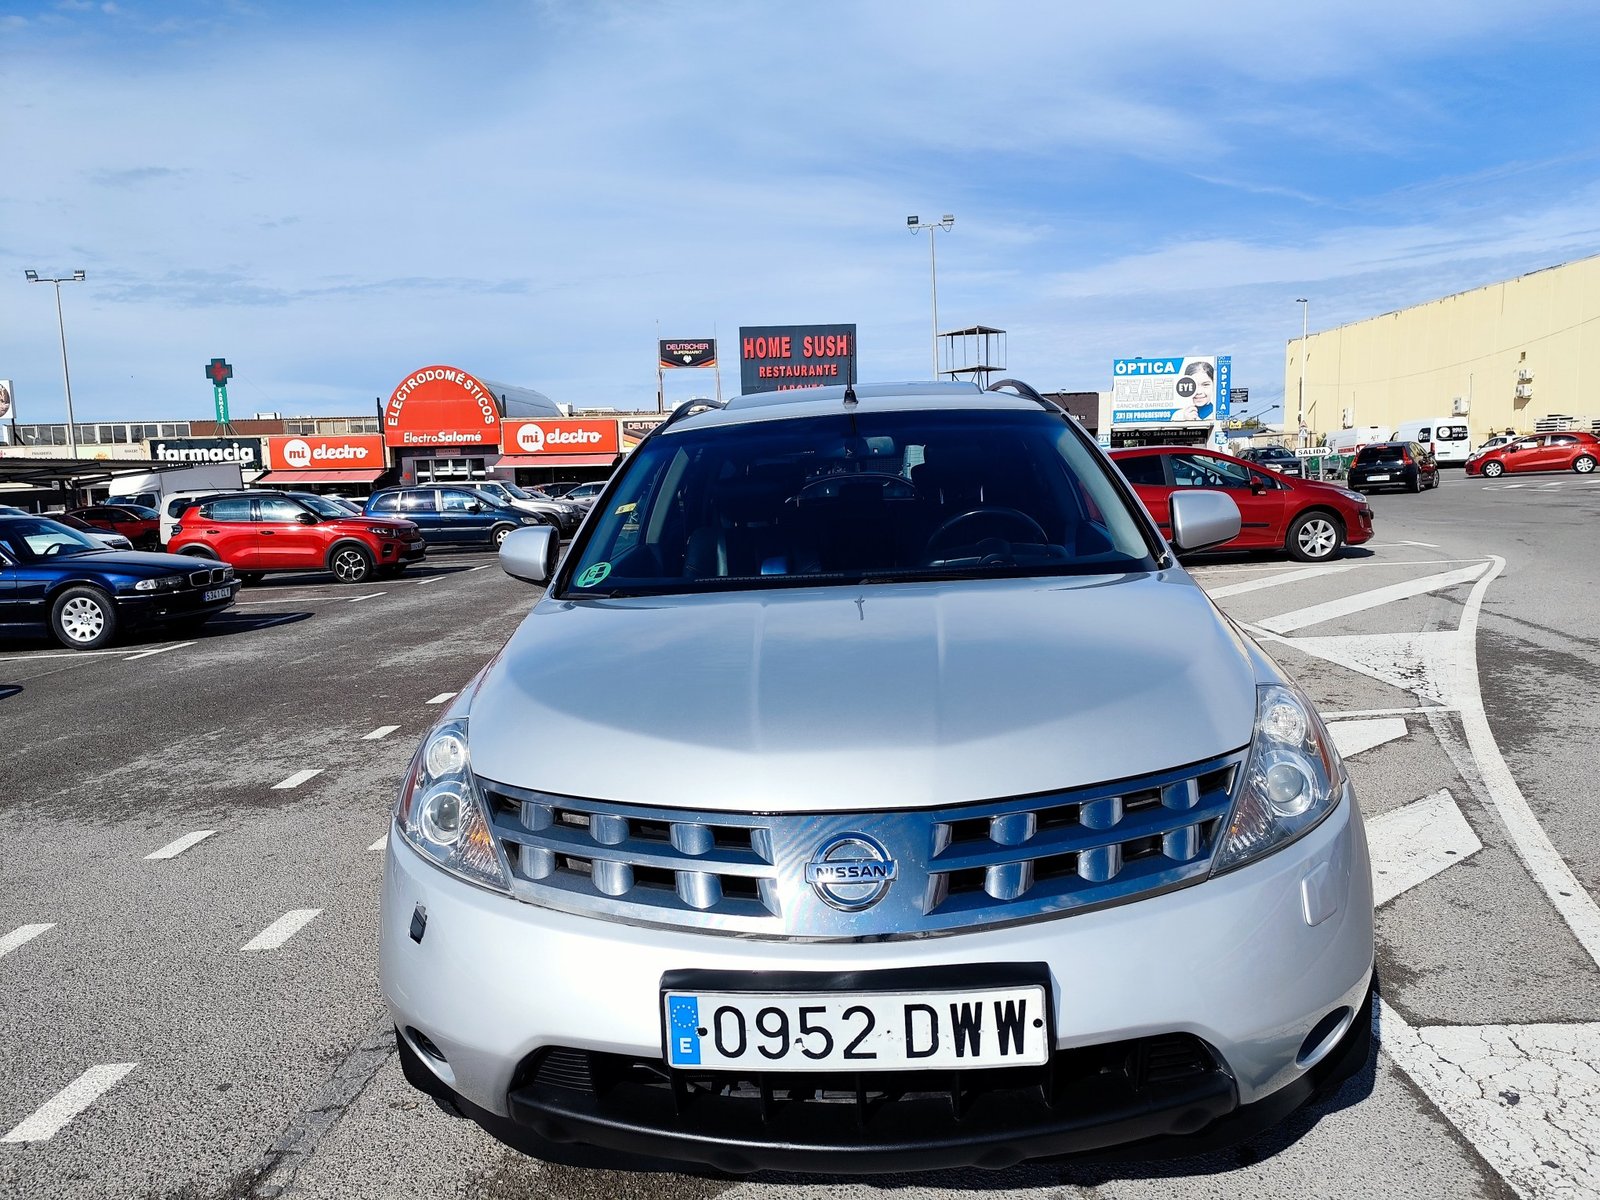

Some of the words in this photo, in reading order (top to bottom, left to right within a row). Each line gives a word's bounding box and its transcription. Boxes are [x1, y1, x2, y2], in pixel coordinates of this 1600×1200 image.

[665, 343, 709, 351] DEUTSCHER
[743, 336, 792, 360] HOME
[759, 364, 838, 378] RESTAURANTE
[1115, 361, 1176, 375] ÓPTICA
[1178, 382, 1194, 392] EYE
[217, 387, 226, 422] FARMACIA
[387, 369, 495, 427] ELECTRODOMÉSTICOS
[524, 431, 540, 444] mi
[545, 428, 602, 444] electro
[156, 443, 254, 461] farmacia
[288, 447, 306, 458] mi
[312, 443, 369, 459] electro
[816, 865, 887, 879] NISSAN
[679, 1038, 693, 1054] E
[713, 1004, 878, 1060] 0952
[904, 999, 1027, 1058] DWW
